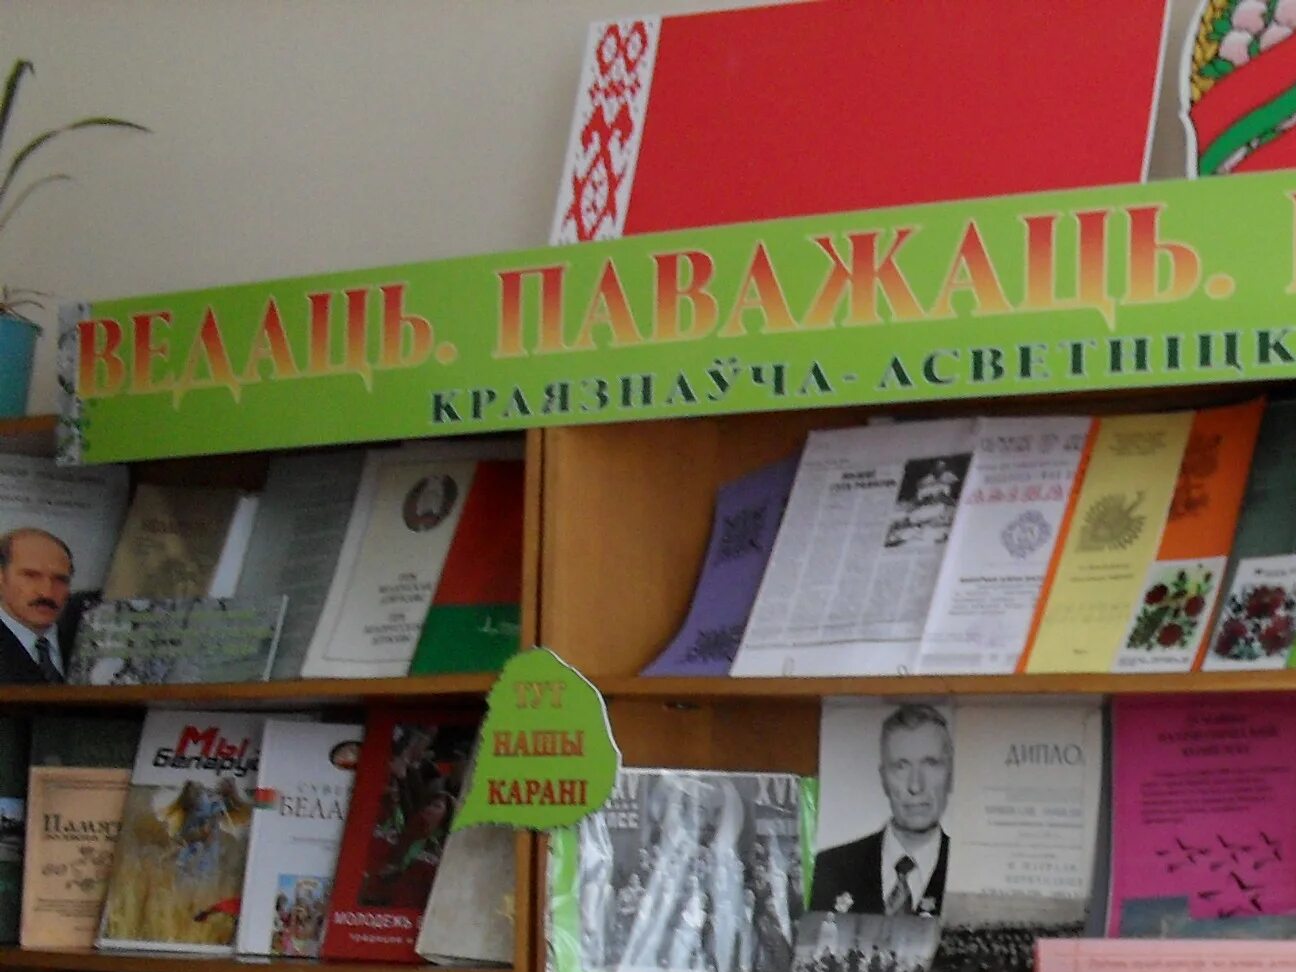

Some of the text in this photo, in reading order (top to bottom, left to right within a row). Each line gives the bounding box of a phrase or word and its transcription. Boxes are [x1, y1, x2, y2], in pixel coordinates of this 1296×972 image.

[76, 283, 458, 411] ВЕДАЦЬ.
[492, 203, 1236, 358] ПАВАЖАЦЬ.
[513, 681, 567, 709] ТУТ
[492, 729, 585, 758] НАШЫ
[487, 778, 589, 807] КАРАНІ
